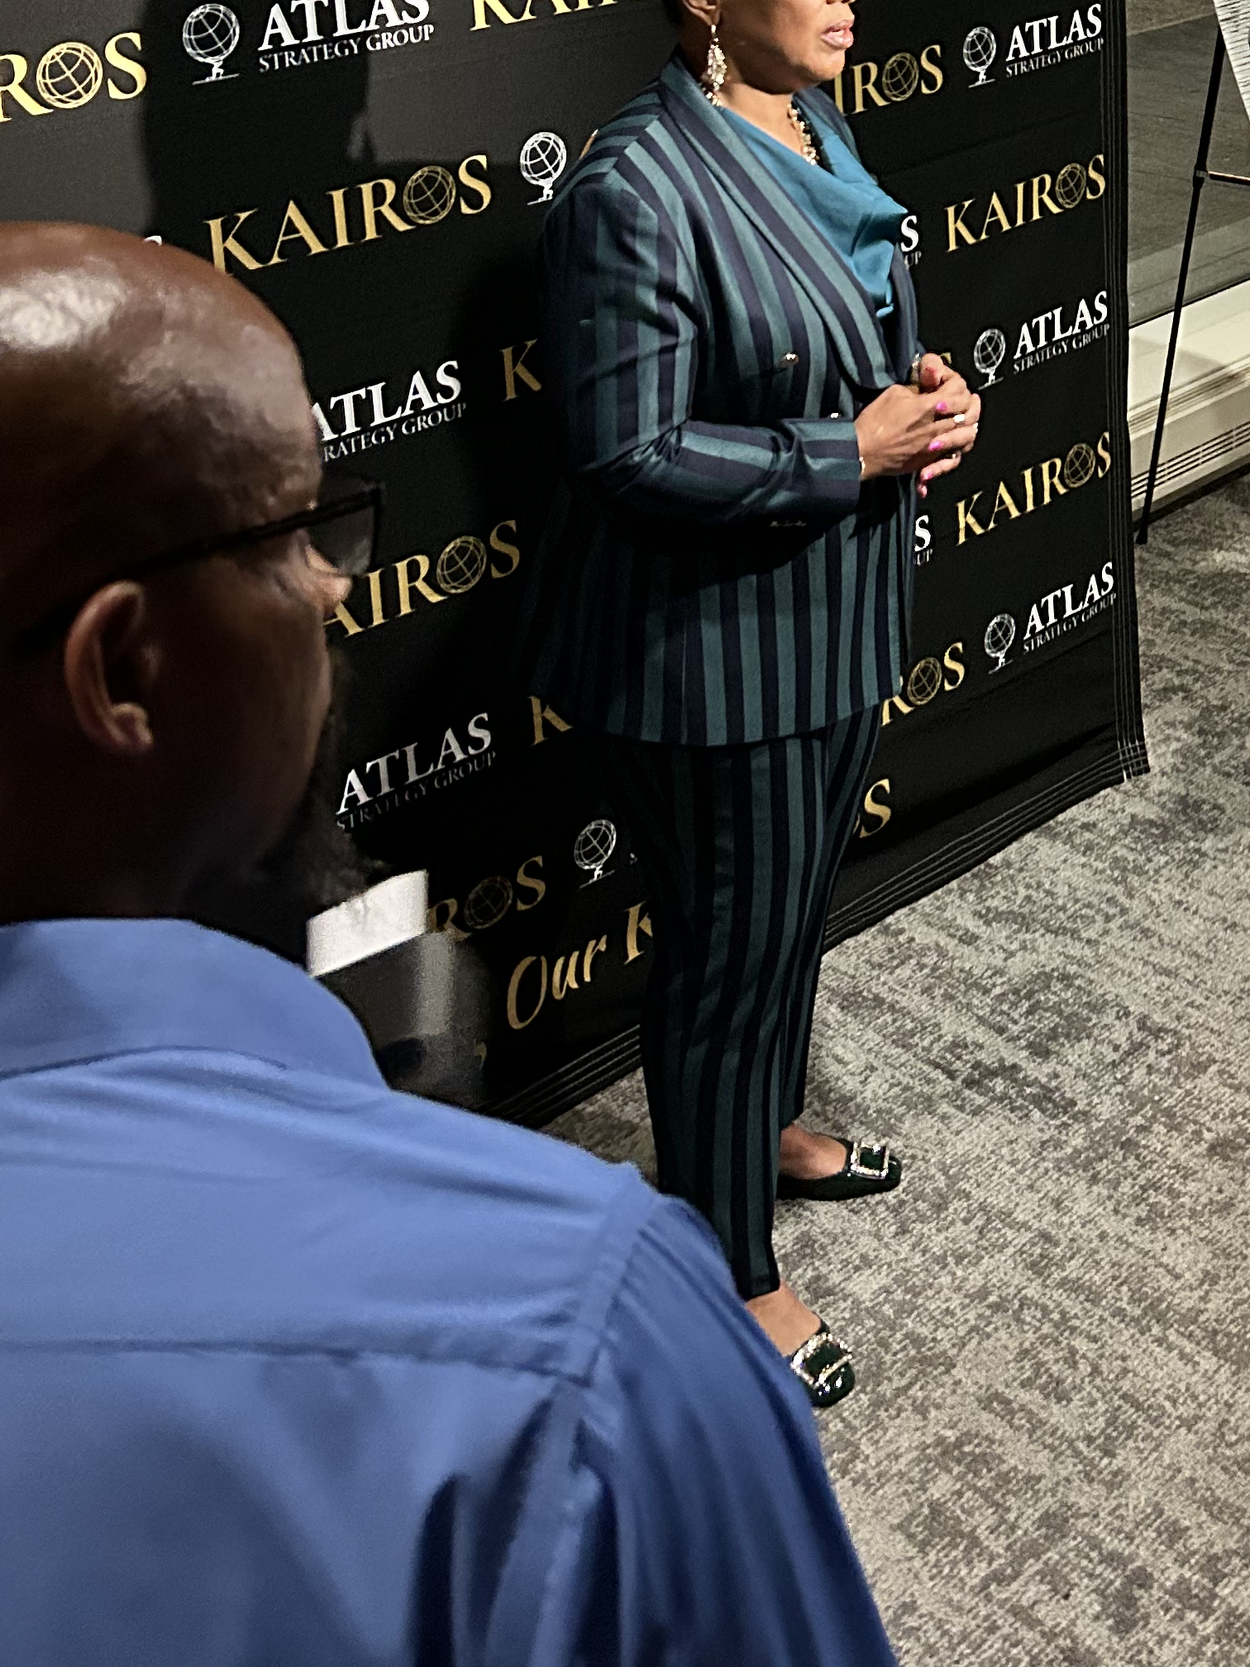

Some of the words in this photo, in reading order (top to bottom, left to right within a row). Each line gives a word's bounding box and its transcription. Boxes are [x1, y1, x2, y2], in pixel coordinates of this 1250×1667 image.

[259, 40, 360, 73] STRATEGY
[365, 24, 435, 52] GROUP
[1006, 3, 1102, 62] ATLAS
[944, 154, 1106, 252] KAIROS
[1013, 290, 1108, 360] ATLAS
[402, 401, 467, 436] GROUP
[956, 431, 1111, 546] KAIROS
[1023, 561, 1114, 641] ATLAS
[335, 713, 492, 816] ATLAS
[434, 751, 497, 791] GROUP
[507, 934, 607, 1029] Our
